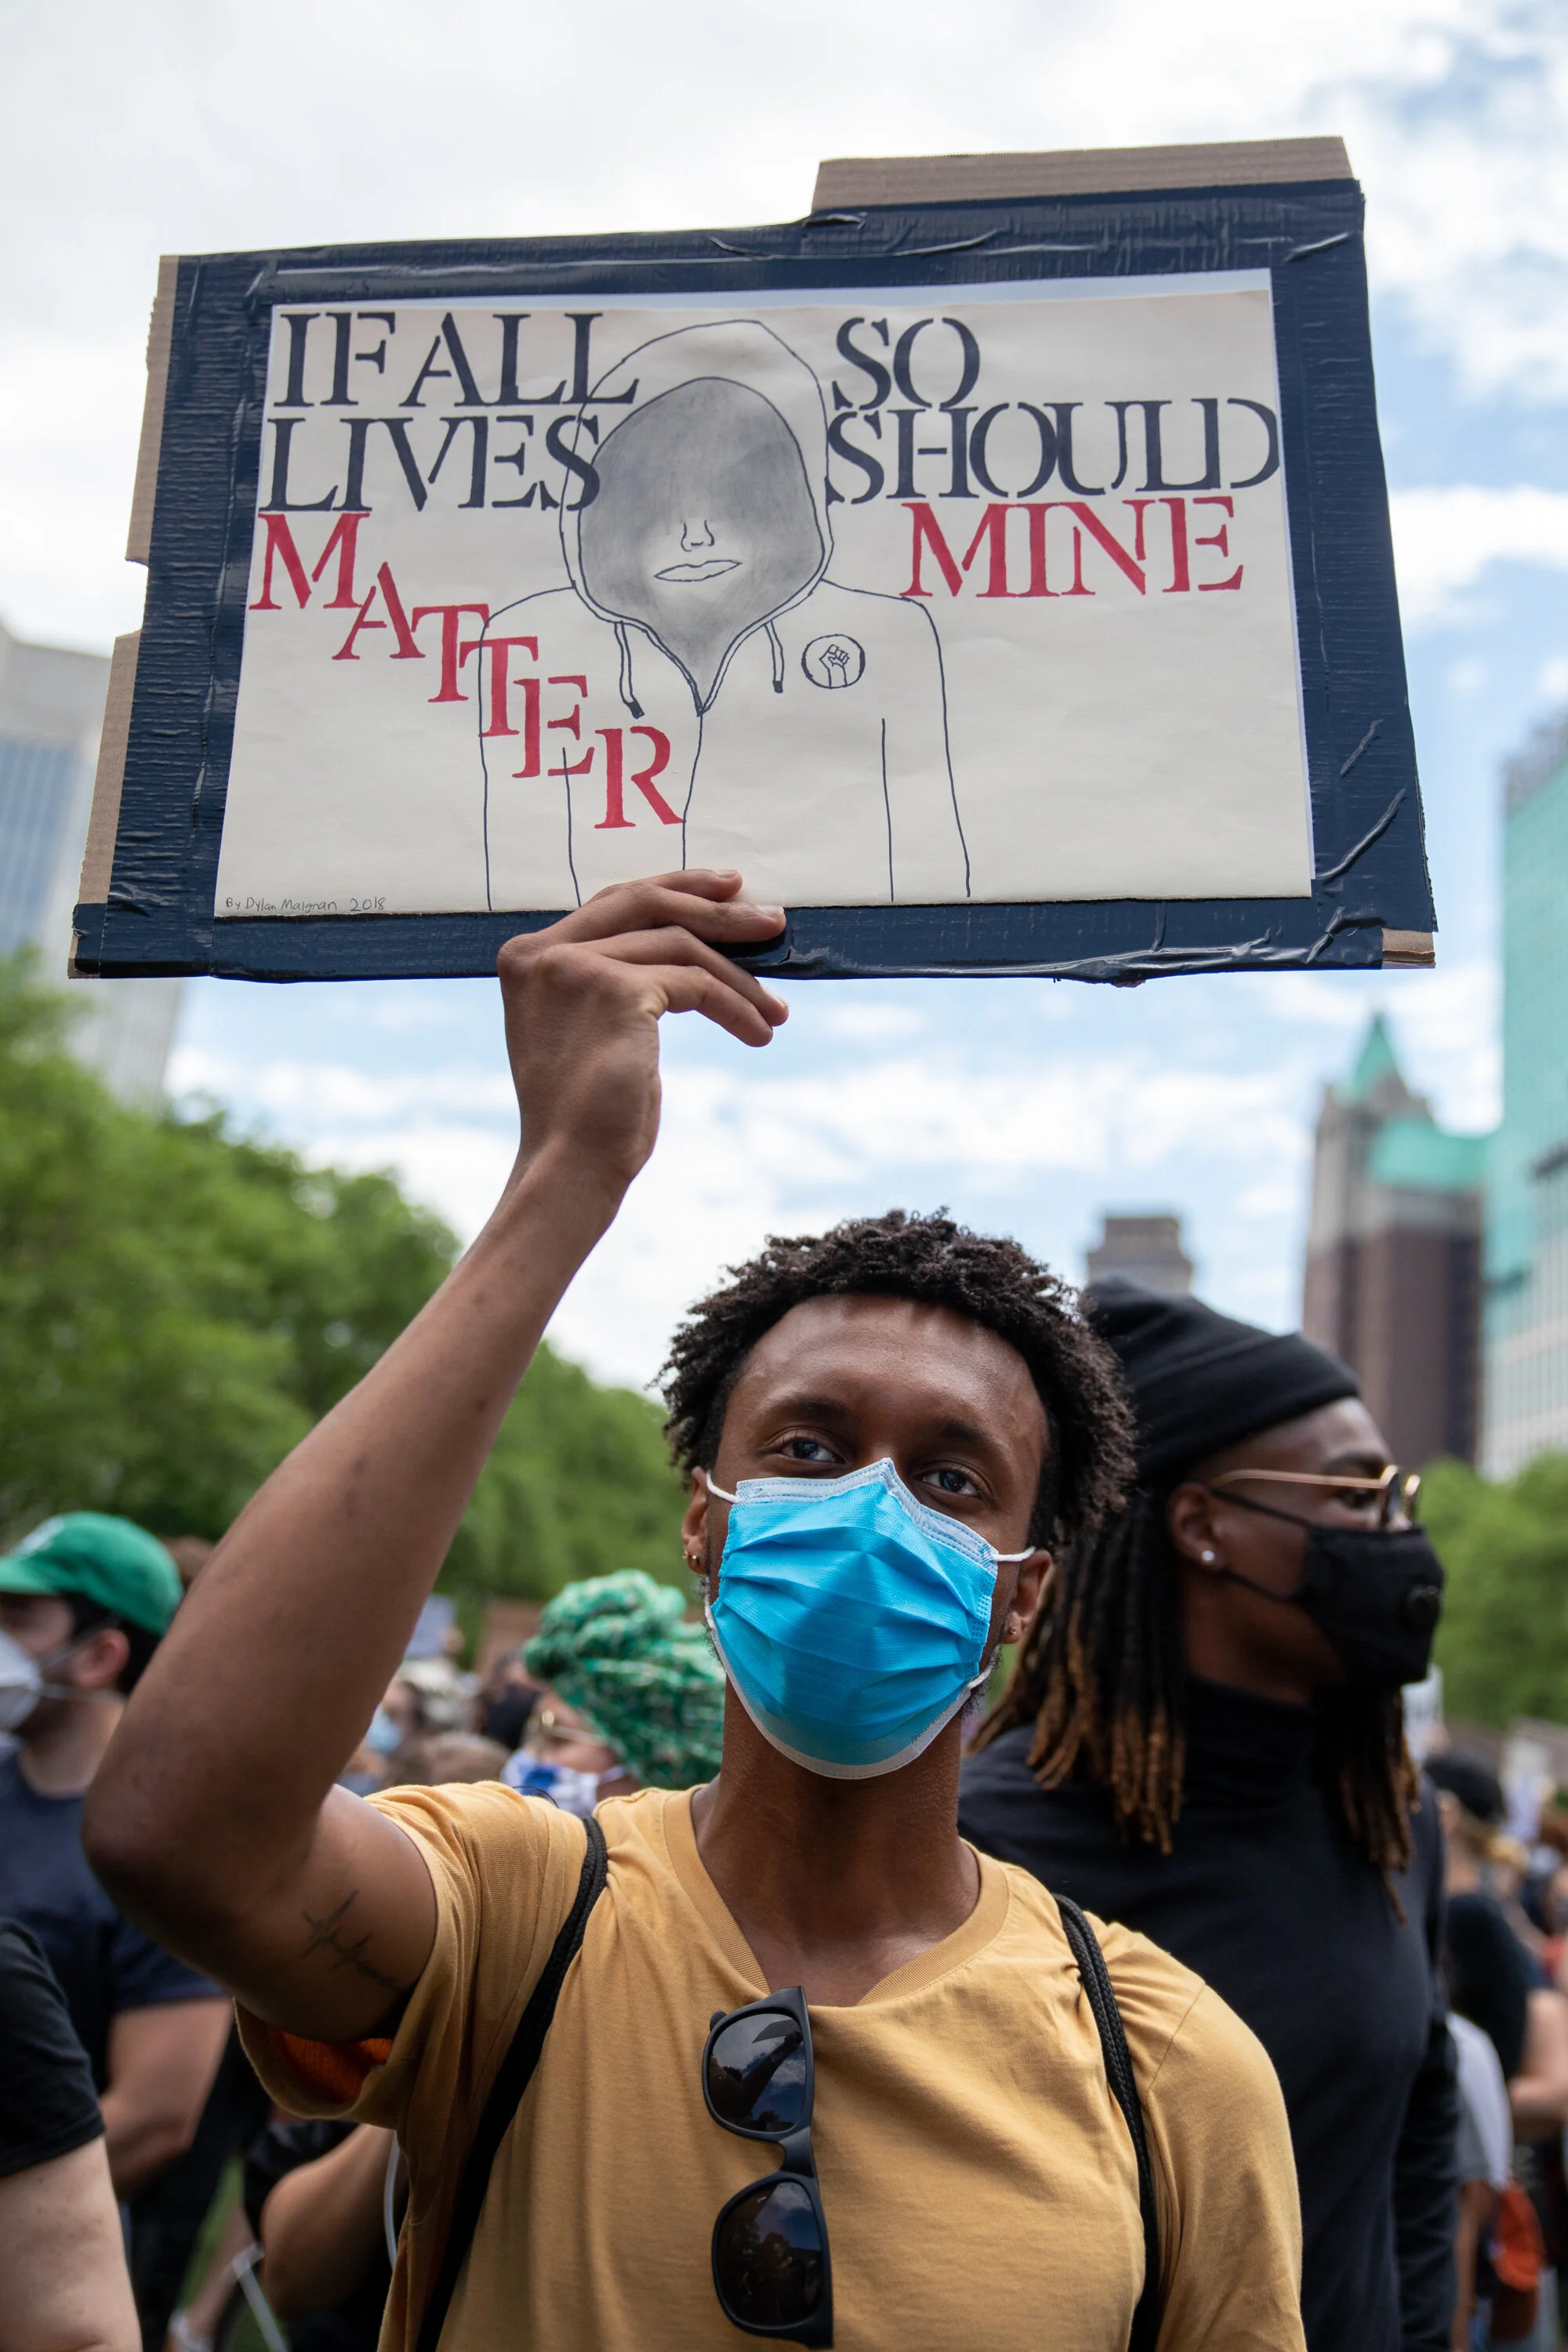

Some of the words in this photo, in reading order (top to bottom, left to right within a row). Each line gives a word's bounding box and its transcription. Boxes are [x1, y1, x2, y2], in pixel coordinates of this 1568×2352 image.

[274, 311, 396, 407] IF
[398, 311, 640, 407] ALL
[832, 317, 981, 411] SO
[258, 414, 601, 511] LIVES
[825, 397, 1281, 505] SHOULD
[898, 496, 1244, 598] MINE
[249, 512, 684, 829] MATTER
[226, 897, 241, 910] By
[245, 896, 277, 913] Dylan
[350, 896, 387, 912] 2018
